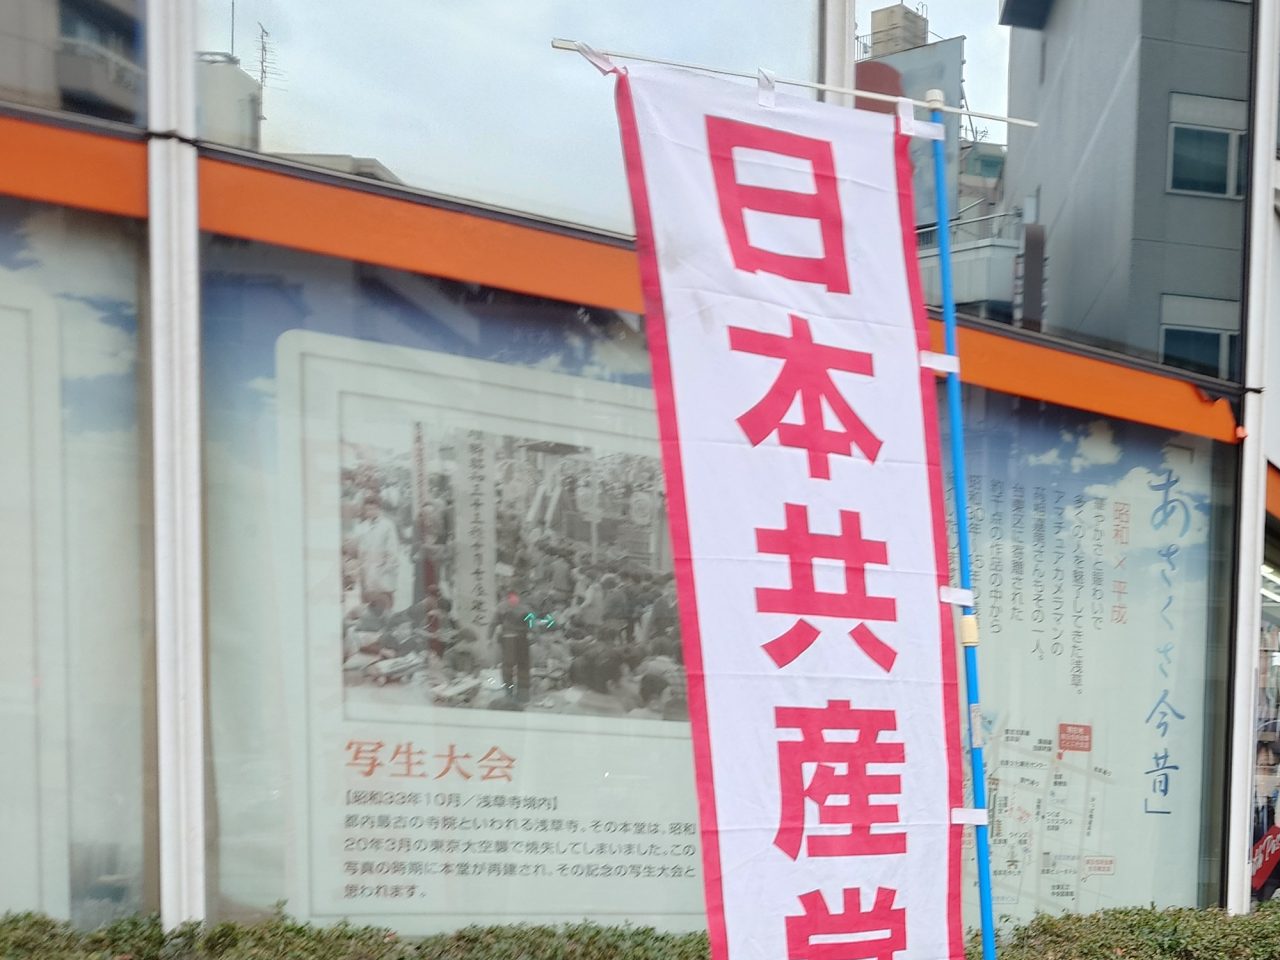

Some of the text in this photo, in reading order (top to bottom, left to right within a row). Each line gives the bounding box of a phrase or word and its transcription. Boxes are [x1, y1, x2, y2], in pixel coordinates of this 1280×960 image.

[1113, 501, 1131, 545] 昭和
[1111, 580, 1128, 625] 平成
[344, 739, 518, 783] 写生大会
